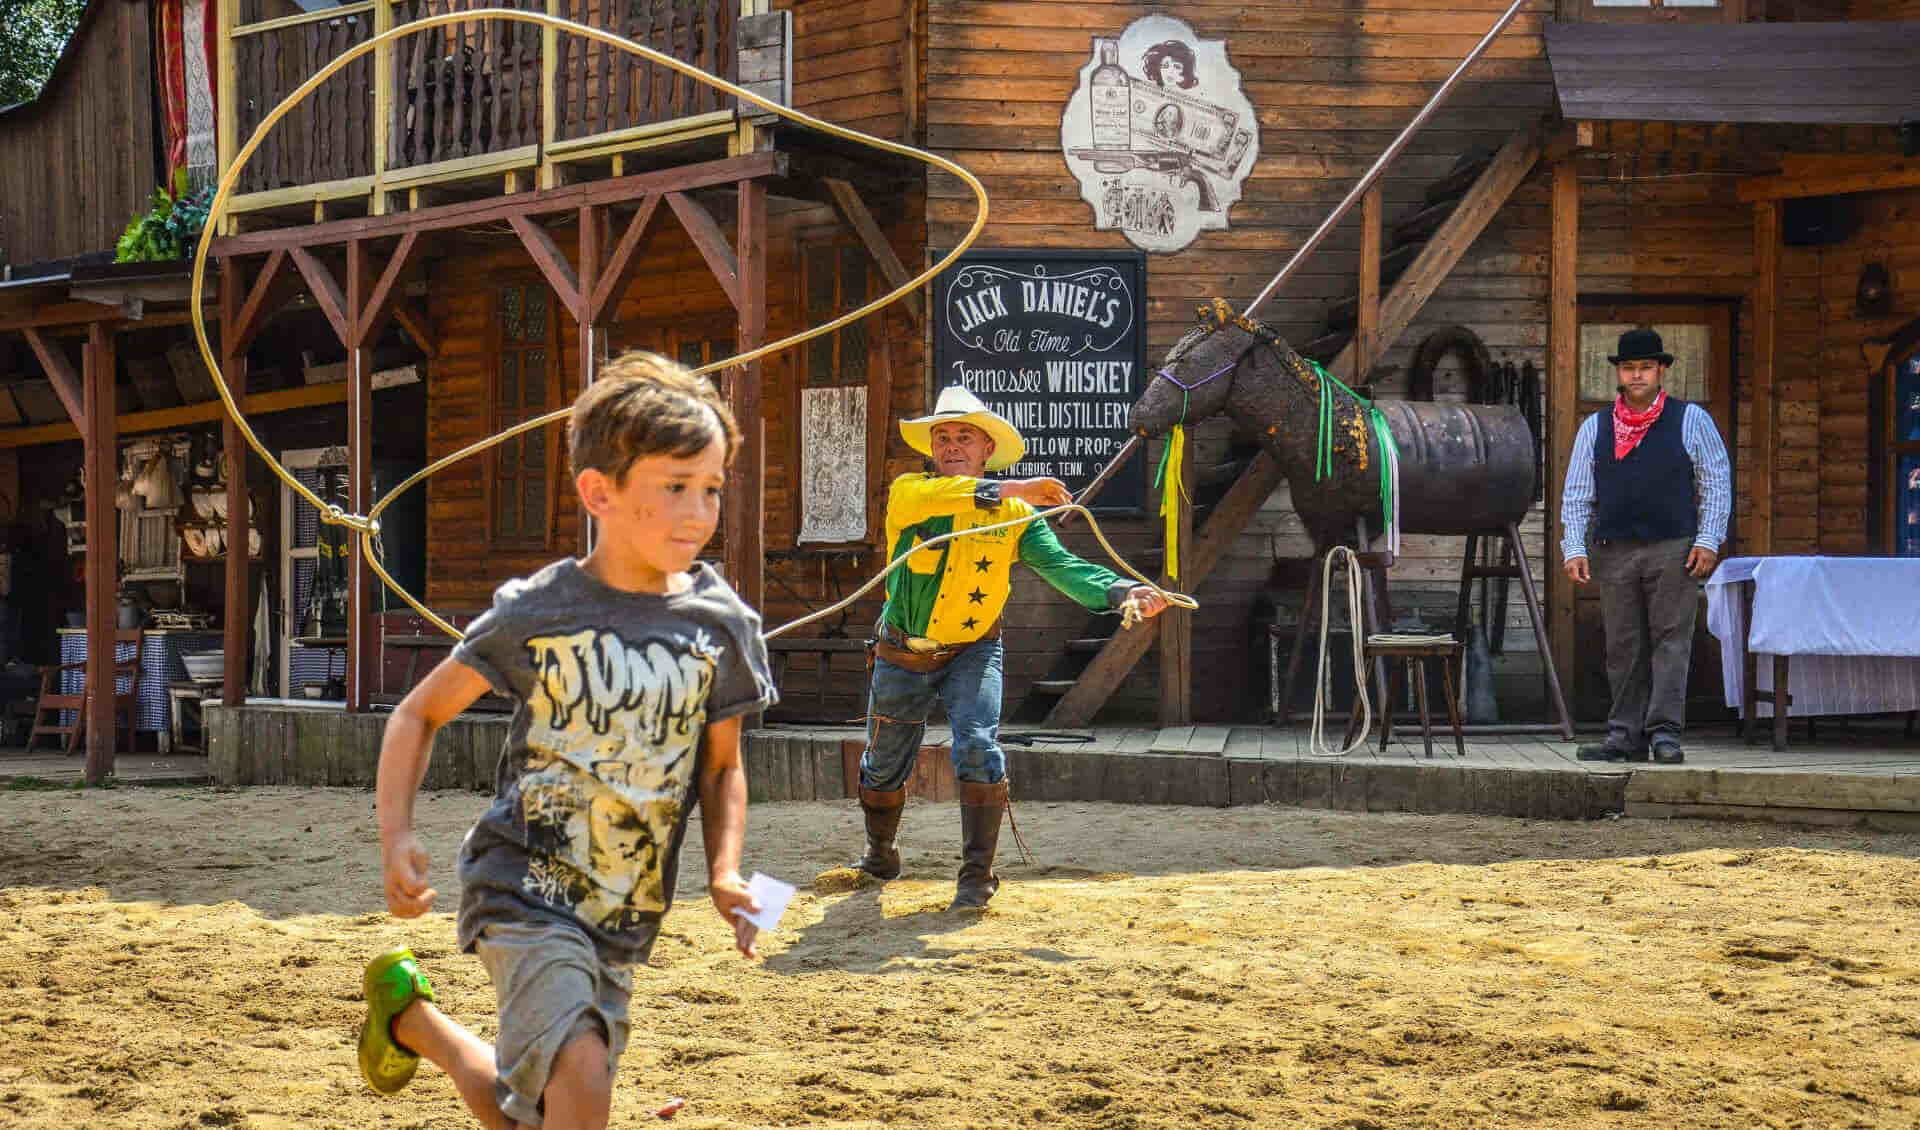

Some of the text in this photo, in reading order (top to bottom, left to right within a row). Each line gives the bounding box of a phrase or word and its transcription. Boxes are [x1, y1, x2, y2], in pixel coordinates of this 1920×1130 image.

[955, 281, 1120, 332] JACK DANIEL'S
[993, 328, 1072, 353] Old Time
[952, 360, 1133, 393] Tennessee WHISKEY
[996, 402, 1047, 429] DANIEL
[1049, 402, 1130, 429] DISTILLERY
